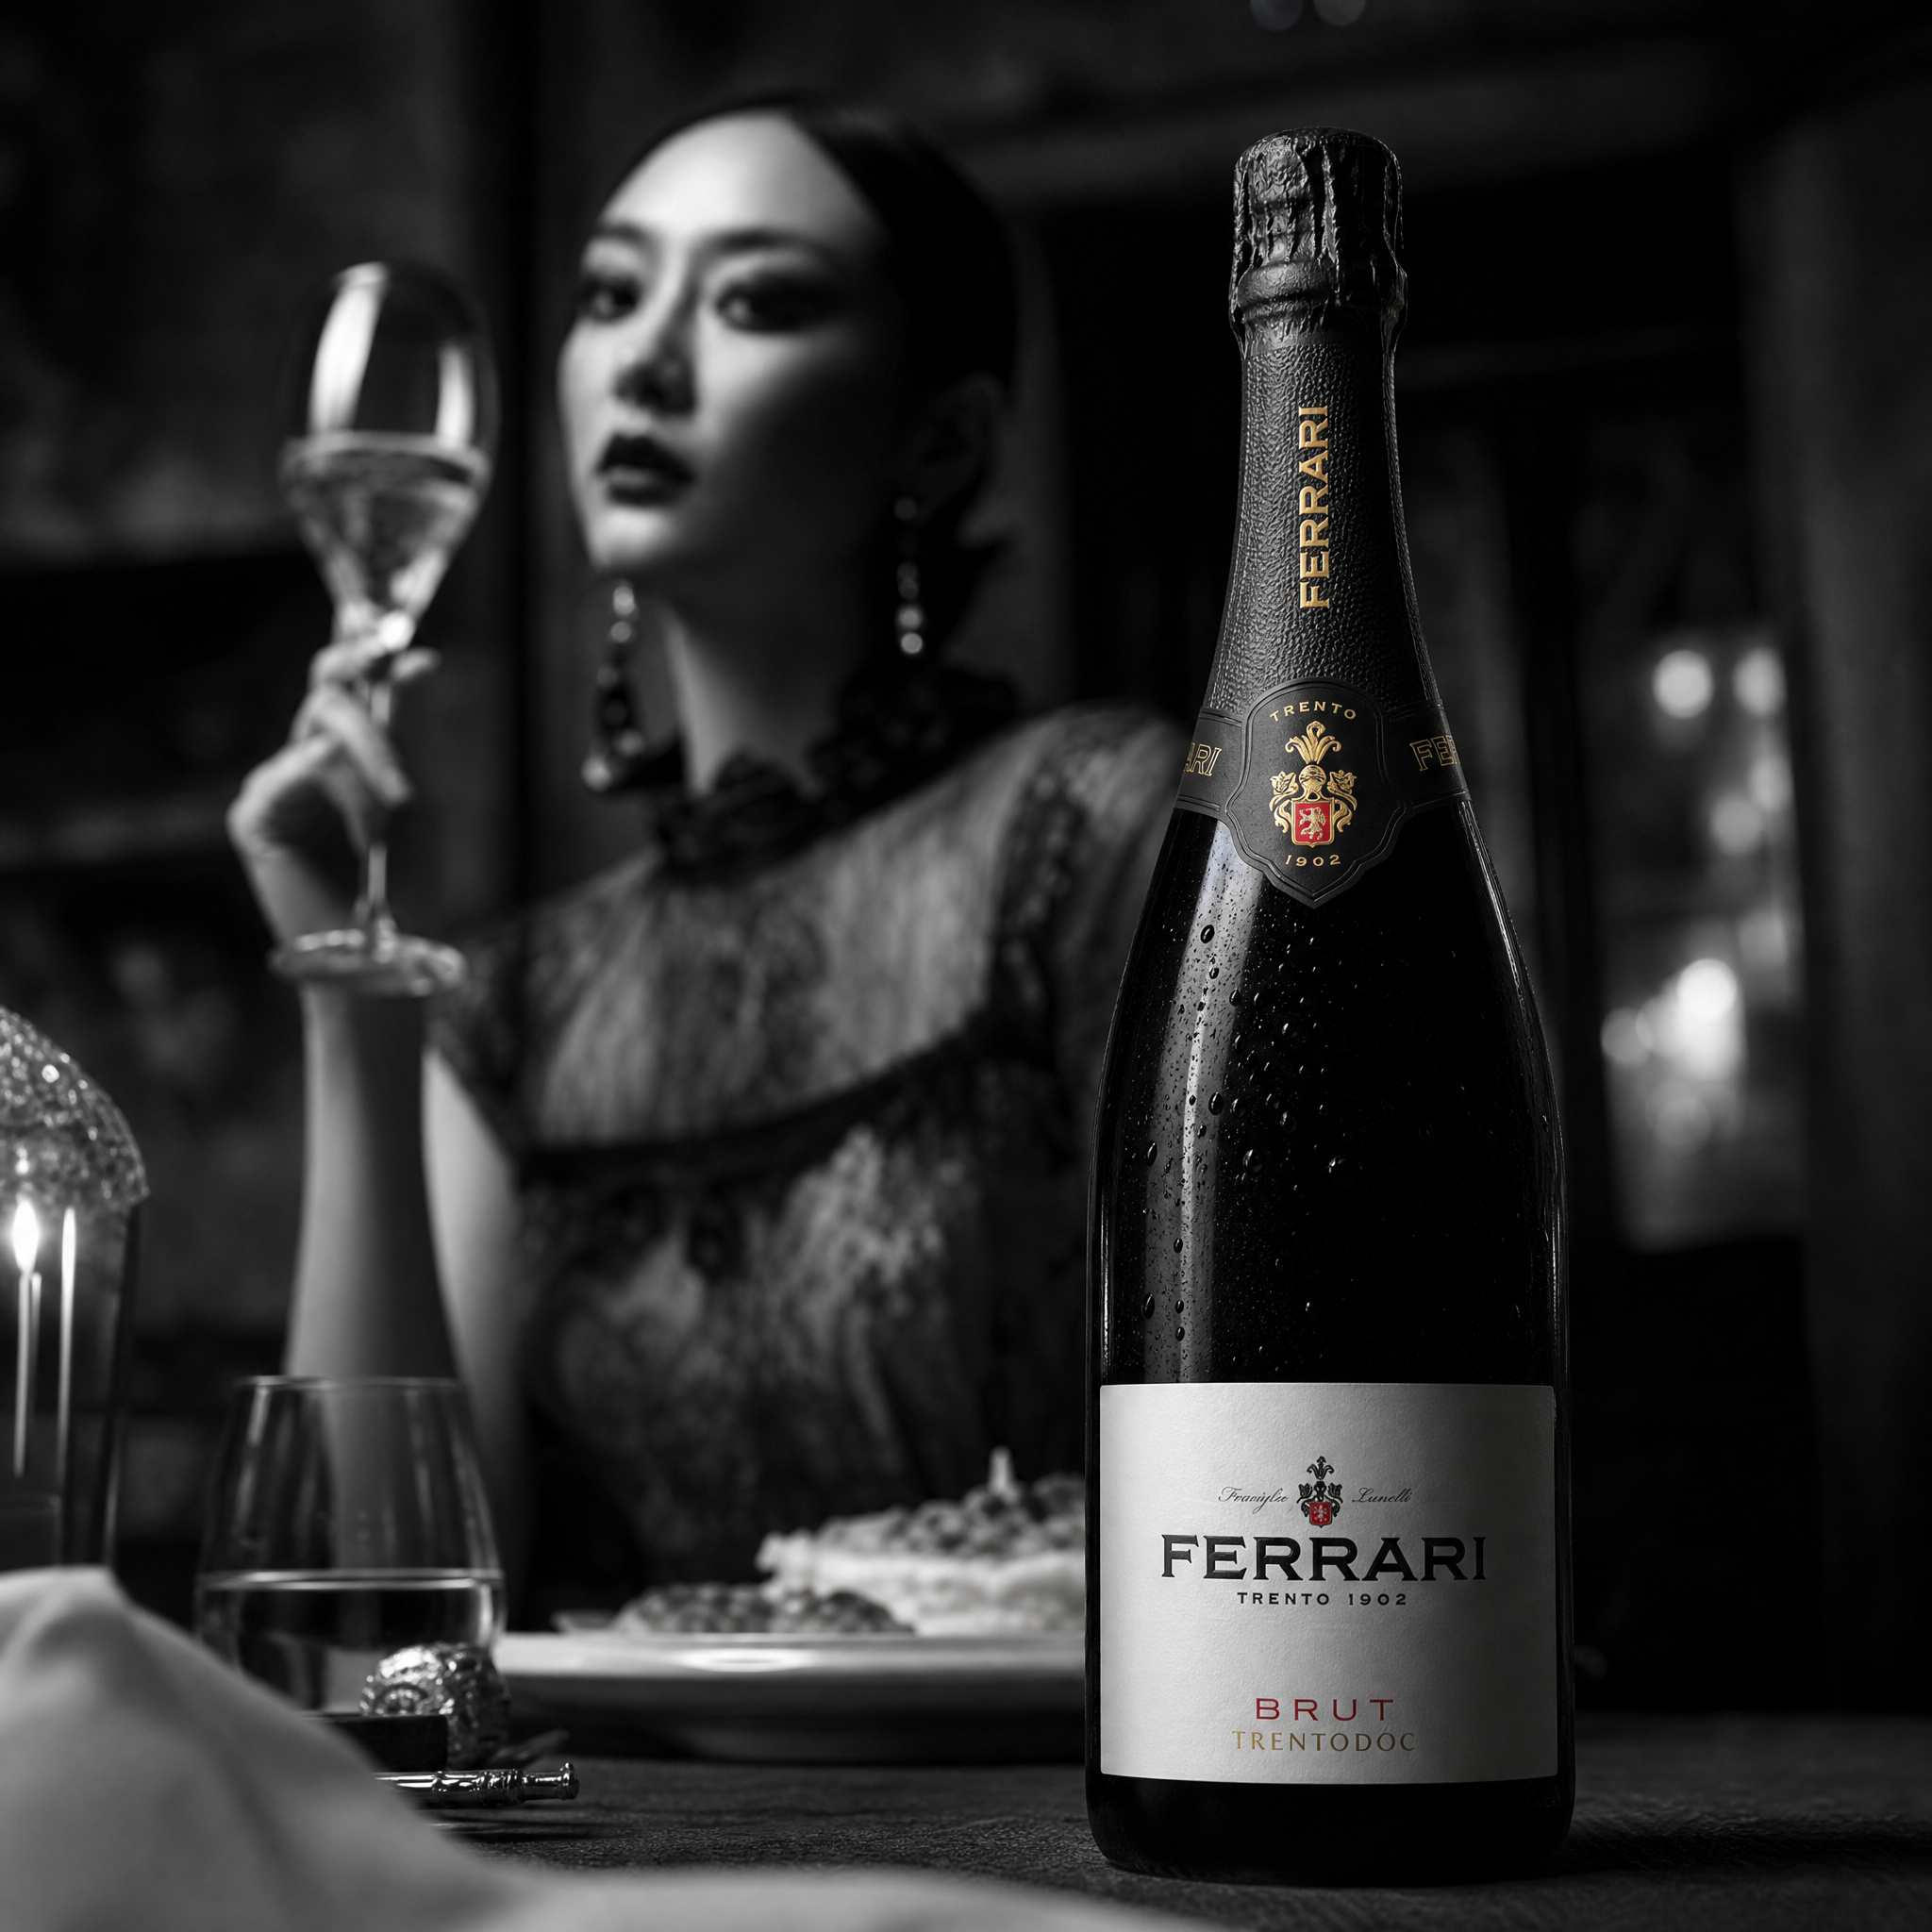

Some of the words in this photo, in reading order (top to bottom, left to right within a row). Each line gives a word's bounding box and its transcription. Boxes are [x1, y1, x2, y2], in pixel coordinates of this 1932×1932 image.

[1298, 406, 1330, 609] FERRARI
[1270, 701, 1357, 723] TRENTO
[1285, 855, 1341, 867] 1902
[1161, 1534, 1487, 1582] FERRARI
[1237, 1591, 1330, 1606] TRENTO
[1348, 1593, 1407, 1607] 1902
[1256, 1697, 1394, 1722] BRUT
